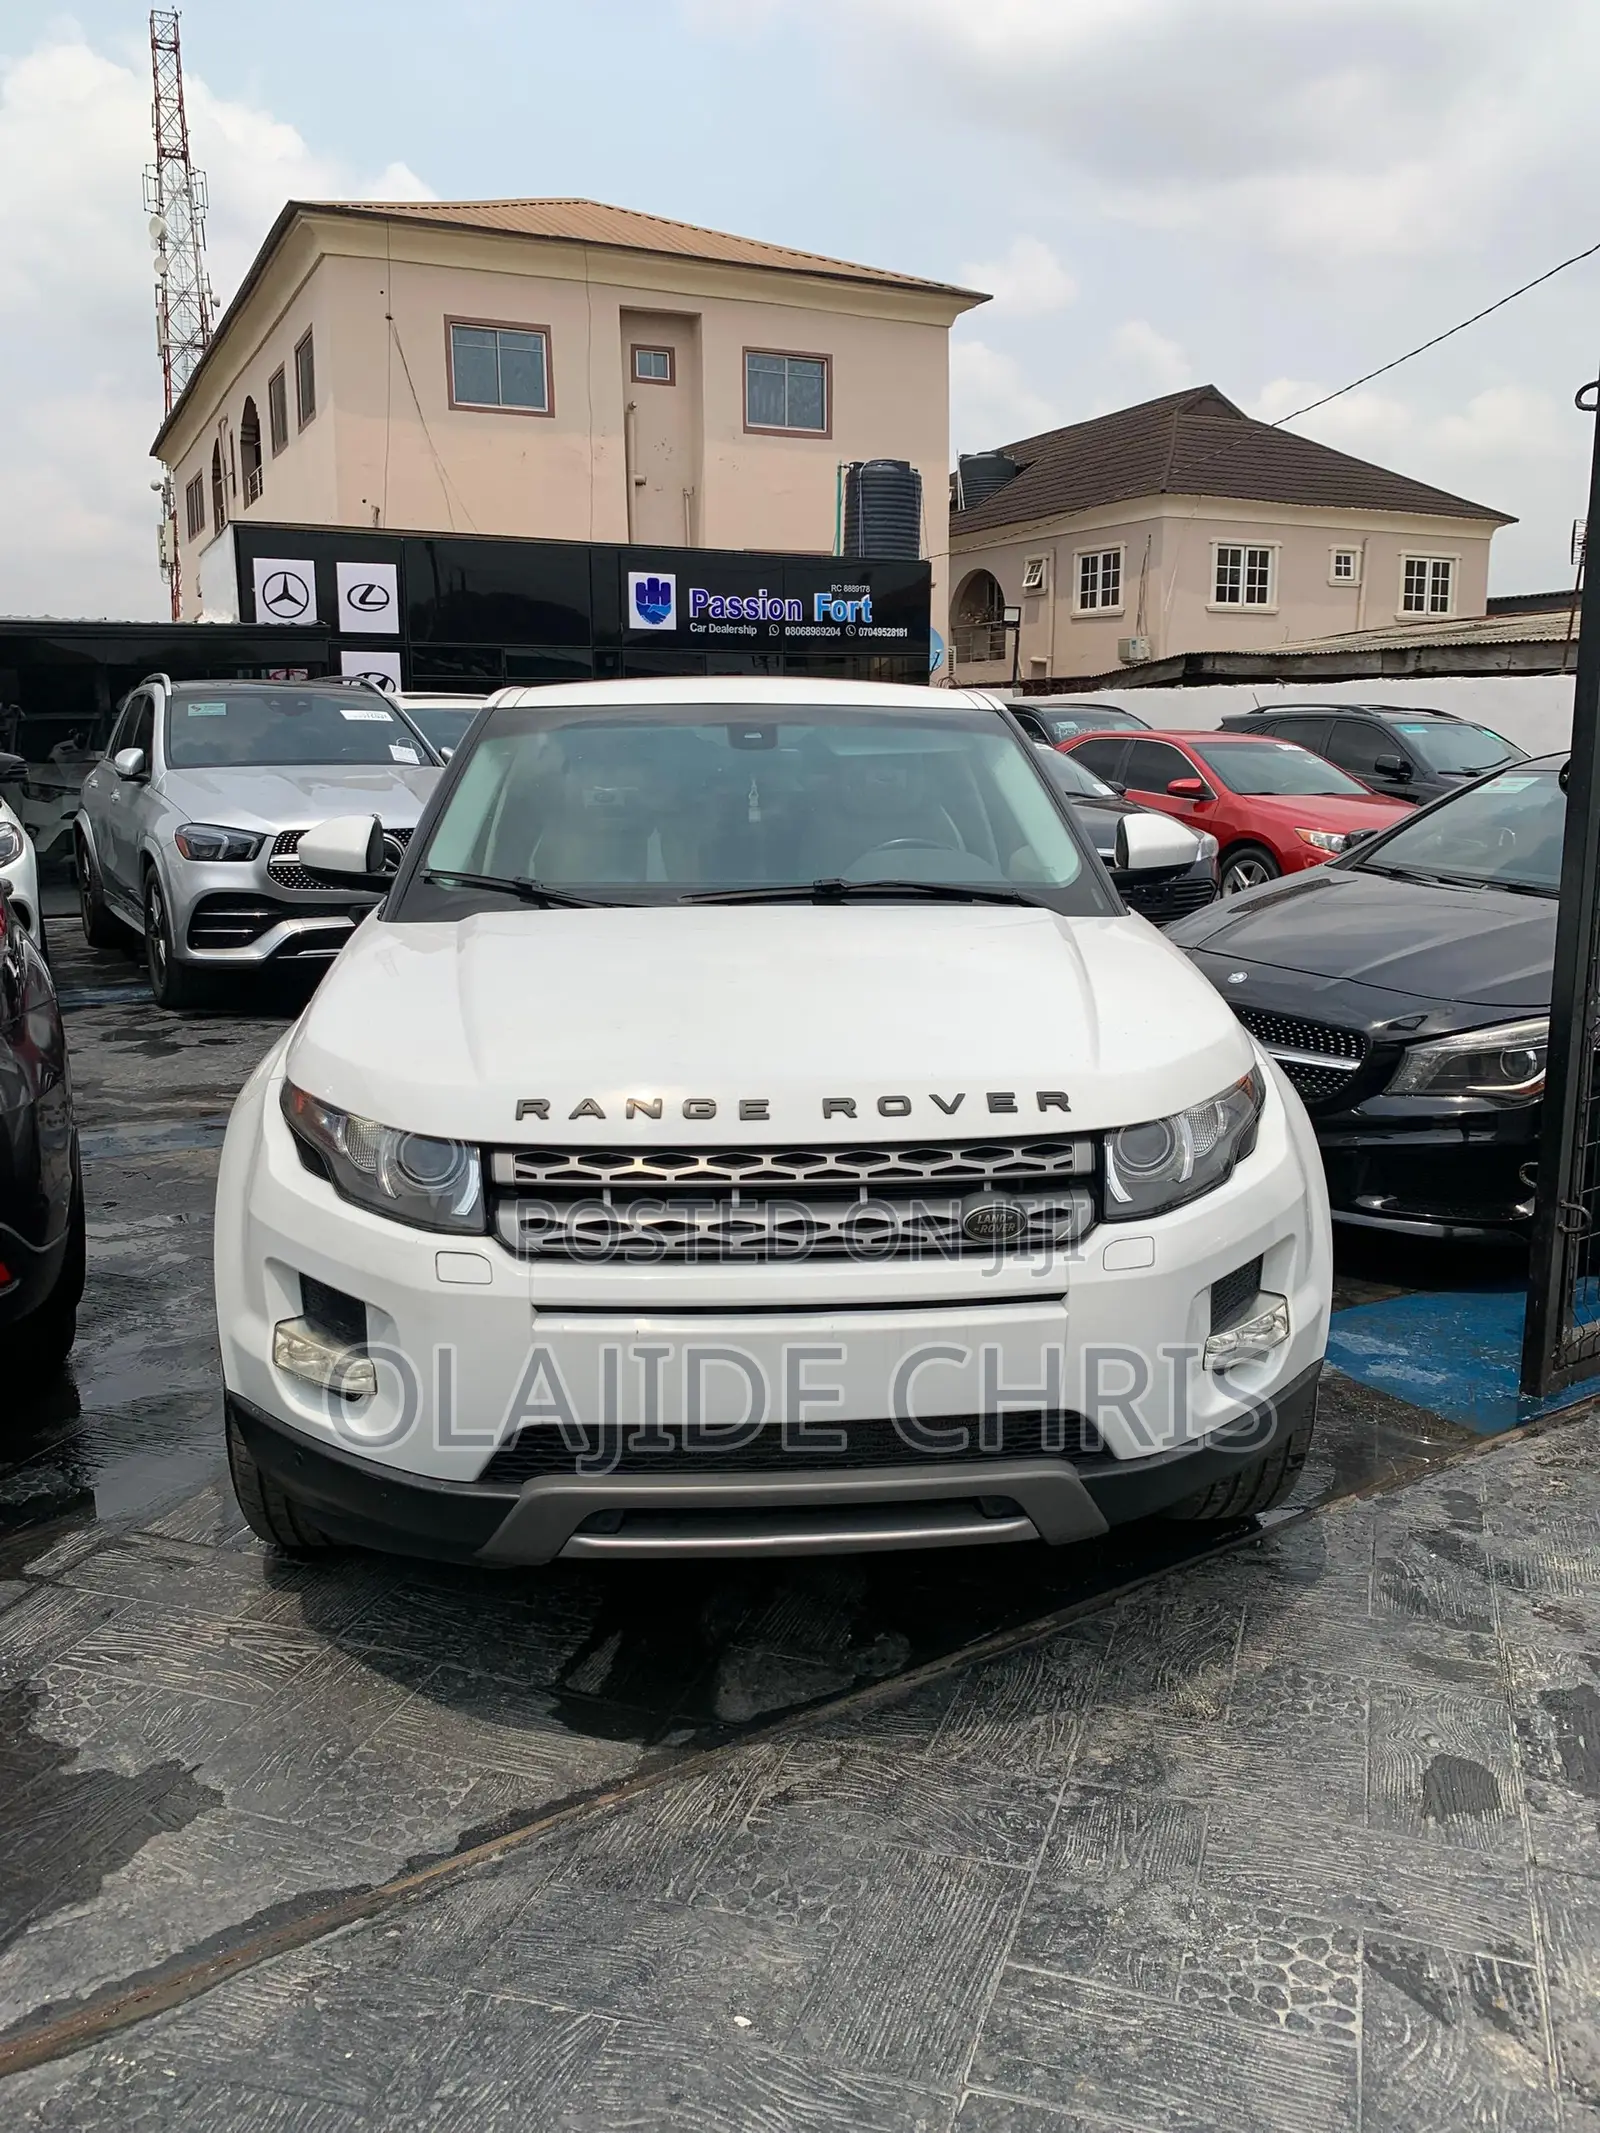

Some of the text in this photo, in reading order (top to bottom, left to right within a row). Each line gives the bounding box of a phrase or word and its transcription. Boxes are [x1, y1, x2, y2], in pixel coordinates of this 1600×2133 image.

[830, 584, 842, 592] RC
[689, 588, 873, 623] Passion Fort
[689, 622, 706, 633] Car
[708, 623, 757, 636] Dealership
[785, 626, 841, 637] 08068989204
[515, 1090, 1072, 1121] RANGE ROVER
